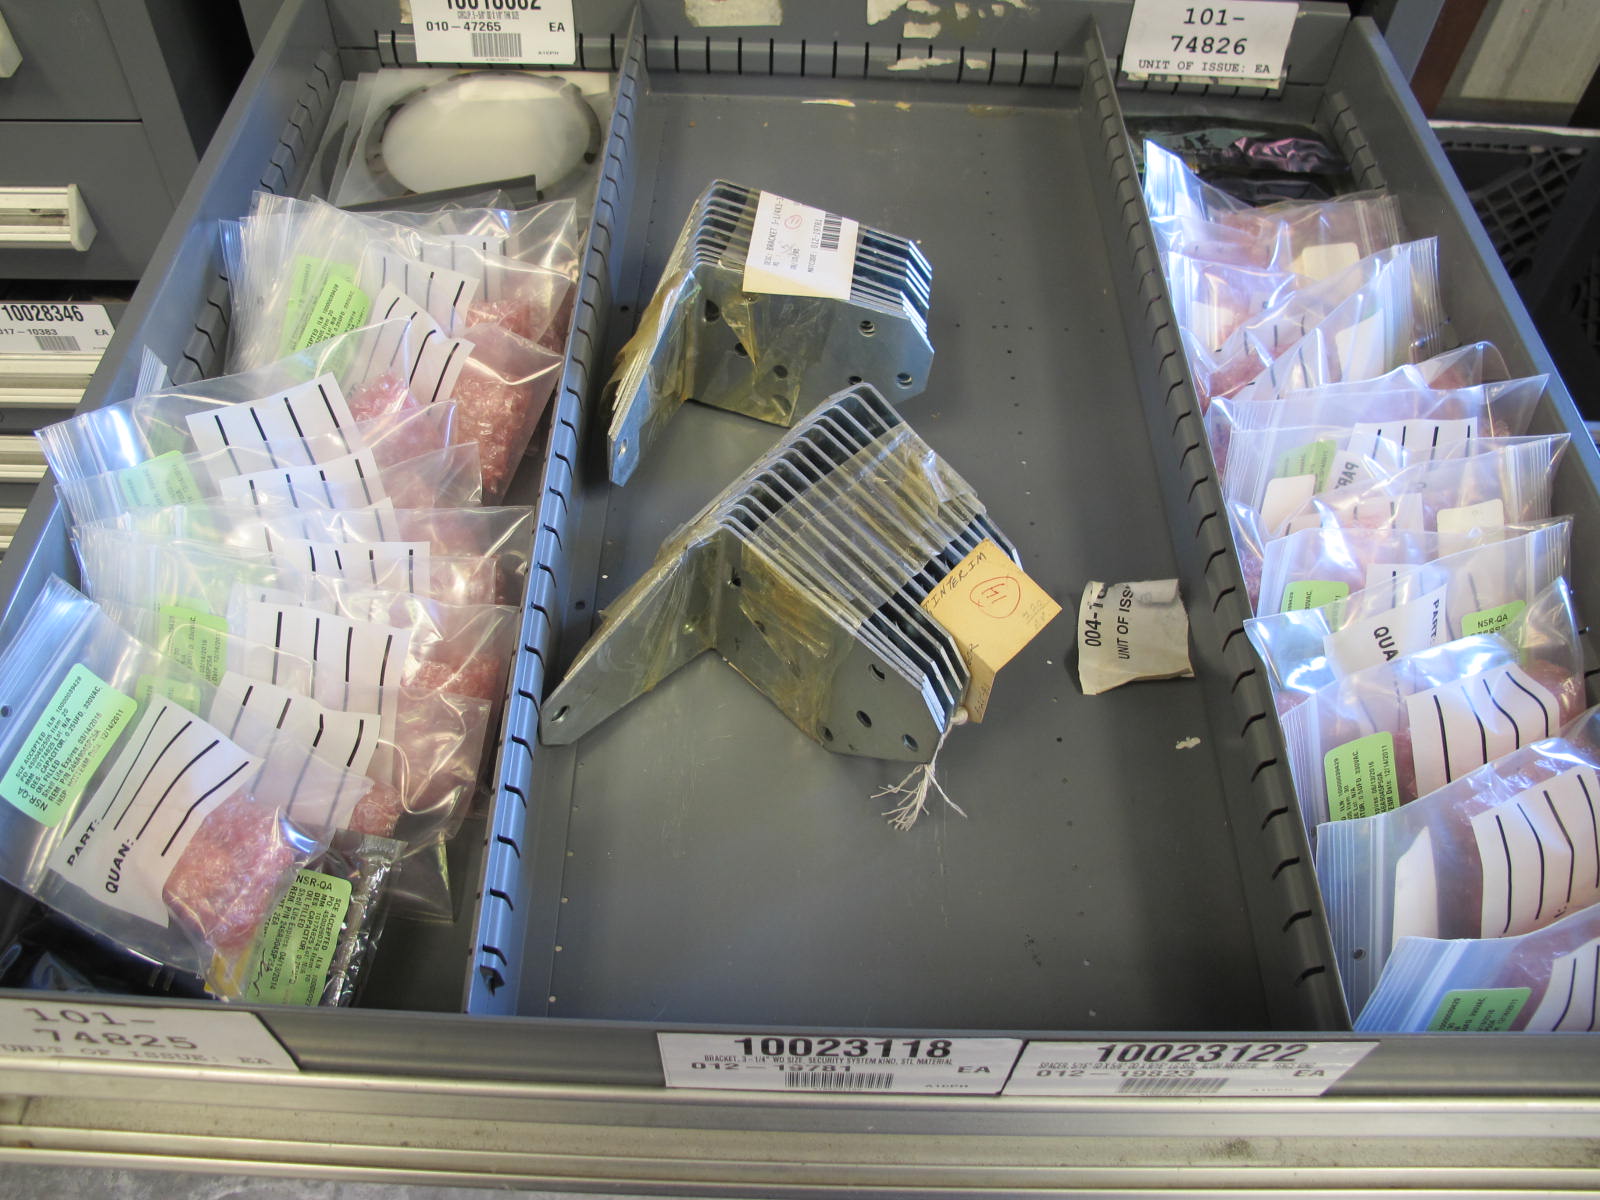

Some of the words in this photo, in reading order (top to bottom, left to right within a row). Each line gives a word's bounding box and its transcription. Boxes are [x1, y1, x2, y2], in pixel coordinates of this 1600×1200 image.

[1183, 7, 1245, 26] 101-
[549, 22, 565, 32] EA
[1171, 35, 1248, 55] 74826
[1138, 59, 1170, 70] UNIT
[1177, 61, 1194, 70] OF
[1201, 62, 1246, 73] ISSUE:
[1254, 64, 1270, 74] EA
[1, 305, 84, 321] 10028346
[1116, 616, 1129, 634] OF
[1477, 613, 1508, 628] NSR-QA
[1116, 638, 1130, 660] UNIT
[22, 730, 47, 764] ACCEPTED
[42, 758, 61, 782] FILLED
[15, 782, 49, 814] NSR-QA
[66, 819, 101, 867] PART:
[105, 838, 135, 894] QUAN:
[294, 874, 334, 890] NSR-QA
[280, 905, 293, 918] P/N
[289, 906, 301, 920] Life
[294, 903, 311, 928] FILLED
[319, 913, 337, 951] ACCEPTED
[23, 1007, 156, 1026] 101-
[32, 1028, 199, 1050] 74825
[734, 1037, 952, 1058] 10023118
[916, 1058, 952, 1066] MATERIAL
[1097, 1043, 1309, 1062] 10023122
[957, 1065, 991, 1073] EA
[1293, 1069, 1325, 1077] EA
